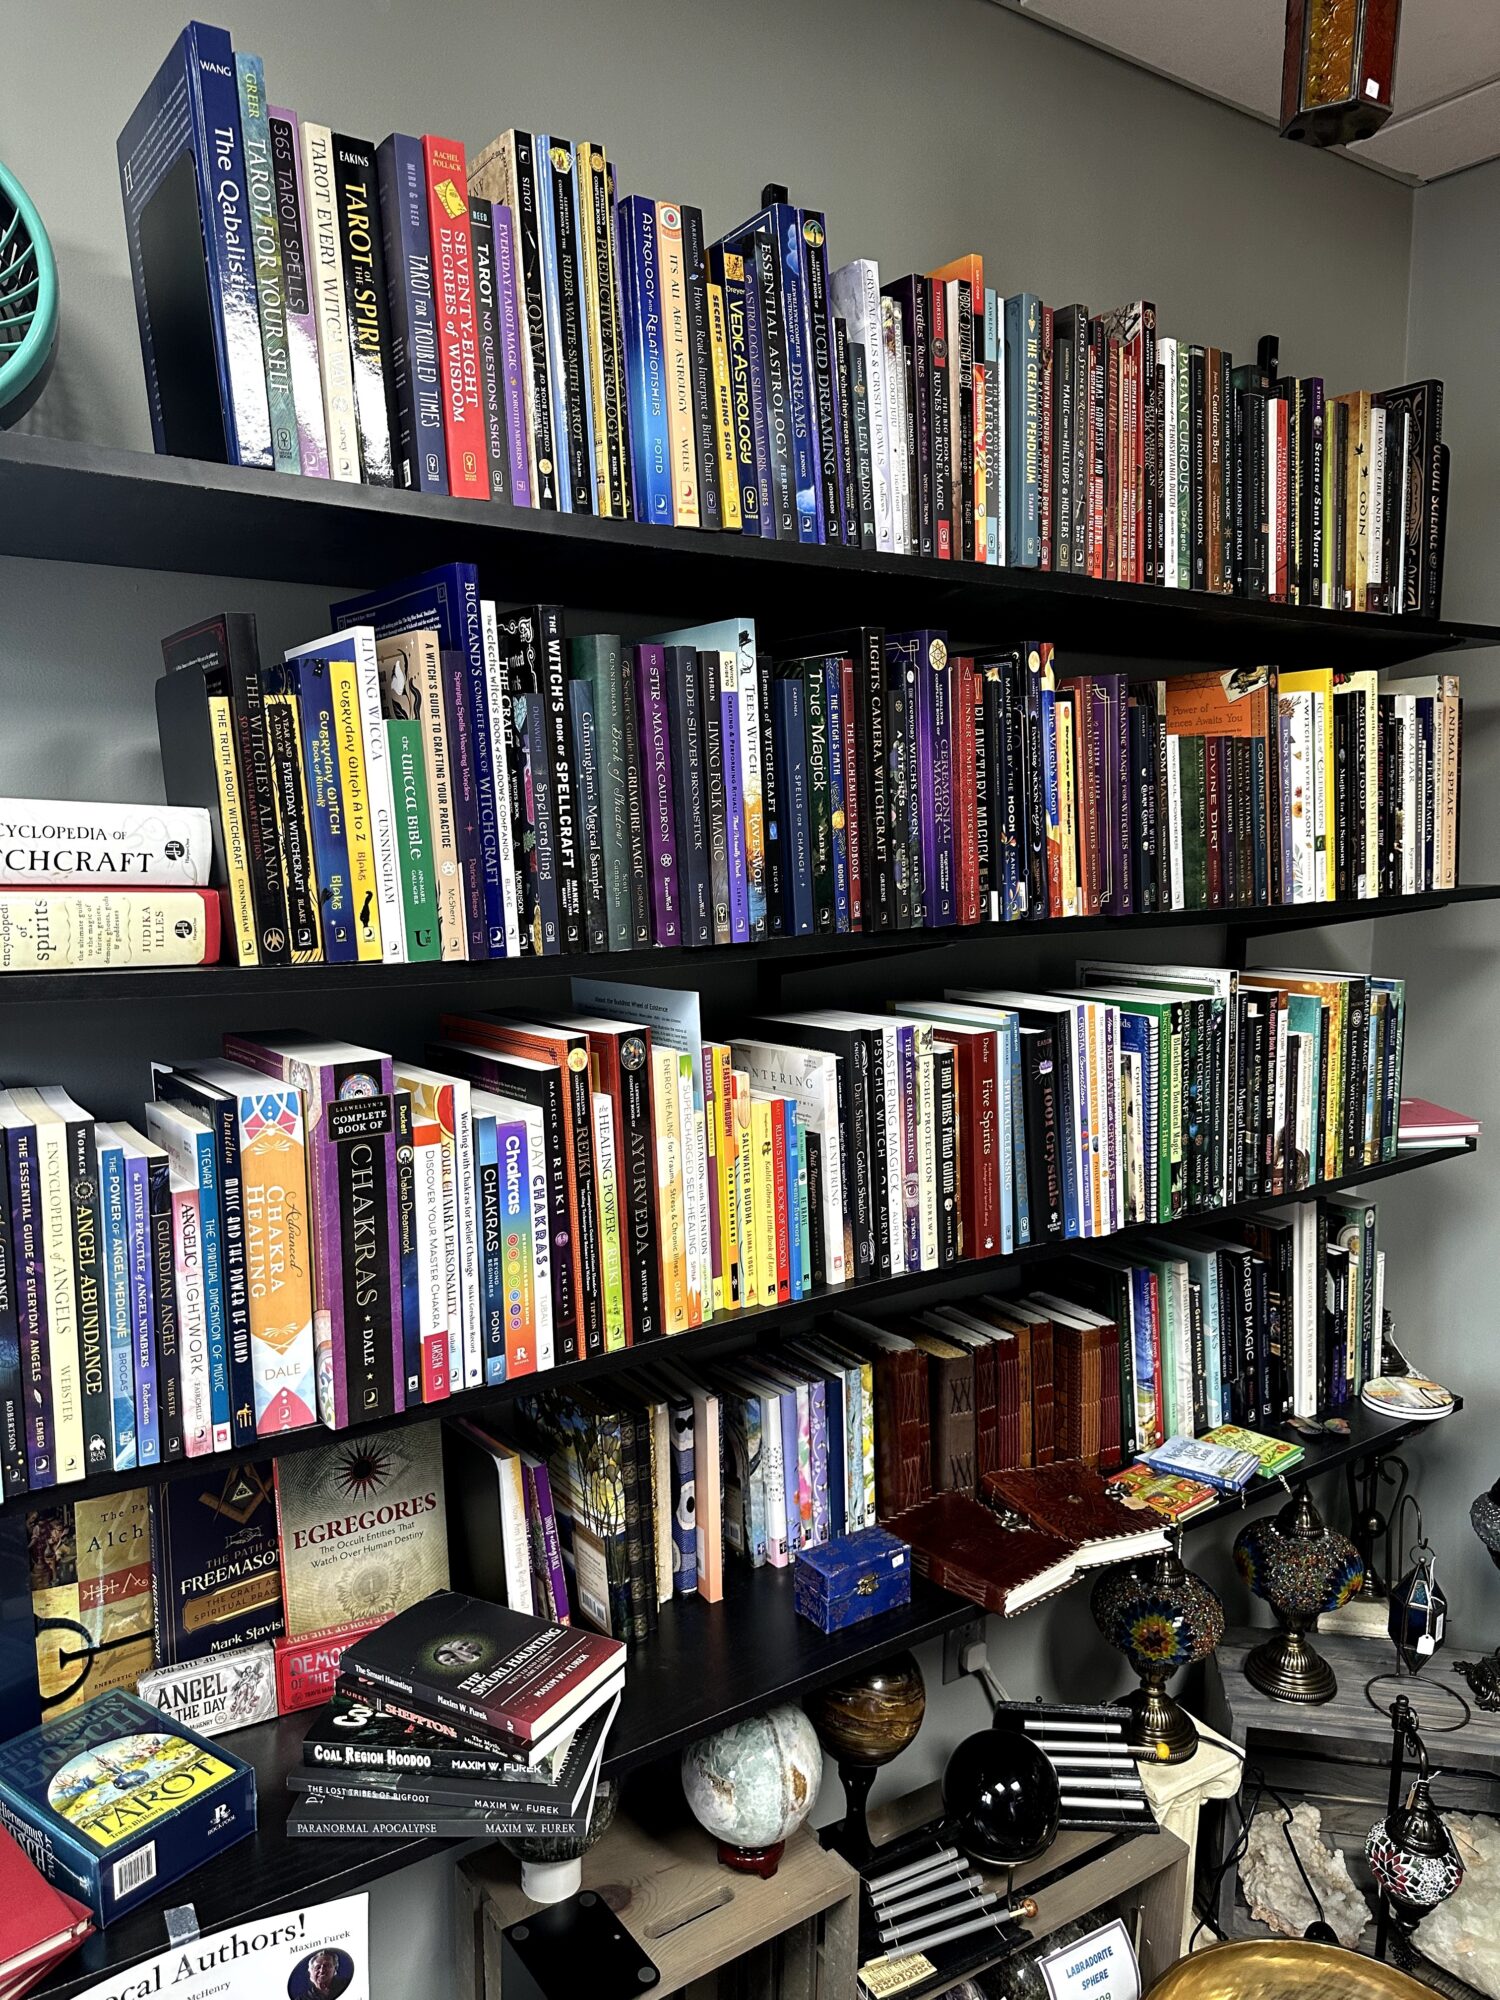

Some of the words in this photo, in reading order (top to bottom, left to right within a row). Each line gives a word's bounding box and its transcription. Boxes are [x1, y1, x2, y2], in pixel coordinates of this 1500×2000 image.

[200, 59, 232, 77] WANG
[245, 72, 260, 119] GREER
[215, 127, 232, 173] The
[273, 124, 290, 160] 365
[340, 151, 369, 167] EAKINS
[432, 159, 461, 172] POLLACK
[433, 151, 459, 162] RACHEL
[247, 138, 271, 217] TAROT
[277, 166, 297, 234] TAROT
[216, 177, 245, 305] Qabalistic
[345, 183, 371, 260] TAROT
[254, 223, 276, 270] FOR
[285, 240, 304, 307] SPELLS
[440, 228, 457, 316] DEGREES
[477, 244, 493, 307] TAROT
[761, 243, 778, 340] ESSENTIAL
[260, 274, 281, 337] YOUR
[446, 319, 455, 337] of
[454, 231, 478, 407] SEVENTY-EIGHT
[483, 312, 492, 330] NO
[729, 301, 744, 353] VEDIC
[814, 313, 827, 370] LUCID
[1026, 338, 1036, 360] THE
[267, 341, 288, 394] SELF
[445, 342, 465, 422] WISDOM
[482, 335, 497, 404] QUESTIONS
[1179, 352, 1188, 396] PAGAN
[734, 356, 752, 464] ASTROLOGY
[768, 348, 788, 459] ASTROLOGY
[1027, 363, 1036, 422] CREATIVE
[490, 407, 500, 460] ASKED
[817, 376, 834, 476] DREAMING
[1179, 402, 1190, 494] CURIOUS
[1026, 426, 1036, 484] PENDULUM
[1314, 442, 1322, 481] Secrets
[1314, 498, 1322, 526] Santa
[1313, 530, 1321, 568] Muerte
[361, 637, 377, 698] LIVING
[548, 639, 565, 713] WITCH'S
[869, 635, 880, 695] LIGHTS,
[809, 669, 823, 716] True
[216, 708, 225, 727] THE
[367, 703, 381, 762] WICCA
[555, 717, 563, 741] BOOK
[871, 698, 883, 760] CAMERA,
[220, 731, 230, 765] TRUTH
[558, 745, 565, 757] OF
[708, 720, 720, 764] LIVING
[811, 724, 826, 792] Magick
[224, 768, 235, 802] ABOUT
[710, 769, 722, 810] FOLK
[113, 831, 128, 840] OF
[556, 760, 575, 869] SPELLCRAFT
[875, 765, 886, 863] WITCHCRAFT
[0, 849, 153, 872] CHCRAFT
[228, 808, 244, 872] WITCHCRAFT
[377, 809, 395, 904] CUNNINGHAM
[712, 815, 724, 862] MAGIC
[36, 900, 56, 961] spirits
[142, 906, 150, 952] JUDIKA
[156, 910, 164, 948] ILLES
[874, 1039, 884, 1104] PSYCHIC
[1172, 1037, 1182, 1089] Blackthorn's
[982, 1078, 994, 1107] Five
[1172, 1090, 1182, 1132] Botanical
[332, 1110, 387, 1125] COMPLETE
[337, 1121, 366, 1134] BOOK
[368, 1120, 383, 1131] OF
[875, 1109, 885, 1158] WITCH
[983, 1111, 994, 1155] Spirits
[76, 1128, 86, 1175] WOMACK
[742, 1132, 750, 1186] SALTWATER
[1171, 1134, 1181, 1155] Magic
[425, 1150, 435, 1199] DISCOVER
[504, 1135, 520, 1216] Chakras
[630, 1131, 649, 1256] AYURVEDA
[76, 1204, 93, 1274] ANGEL
[181, 1203, 199, 1268] ANGELIC
[266, 1185, 286, 1293] CHAKRA
[285, 1190, 303, 1278] Advanced
[350, 1144, 379, 1307] CHAKRAS
[427, 1202, 436, 1230] YOUR
[246, 1184, 266, 1299] HEALING
[428, 1234, 438, 1279] MASTER
[431, 1283, 440, 1329] CHAKRA
[1241, 1256, 1253, 1314] MORBID
[80, 1277, 102, 1396] ABUNDANCE
[185, 1272, 205, 1376] LIGHTWORK
[363, 1328, 374, 1366] DALE
[1244, 1318, 1255, 1361] MAGIC
[263, 1362, 301, 1381] DALE
[432, 1339, 442, 1370] LARSEN
[35, 1416, 45, 1448] LEMBO
[293, 1492, 437, 1549] EGREGORES
[320, 1546, 334, 1554] The
[337, 1536, 364, 1549] Occult
[367, 1528, 395, 1540] Entities
[398, 1522, 415, 1531] That
[311, 1556, 337, 1569] Watch
[340, 1550, 361, 1560] Over
[364, 1540, 392, 1553] Human
[395, 1531, 424, 1544] Destiny
[355, 1665, 367, 1675] The
[367, 1670, 384, 1682] Smurl
[385, 1676, 412, 1693] Haunting
[457, 1672, 486, 1691] THE
[470, 1663, 512, 1695] SMURL
[509, 1628, 561, 1667] HAUNTING
[157, 1673, 227, 1709] ANGEL
[175, 1707, 200, 1722] THE
[203, 1696, 227, 1714] DAY
[438, 1695, 458, 1709] Maxim
[458, 1703, 468, 1713] W.
[469, 1706, 487, 1720] Furek
[315, 1745, 342, 1761] COAL
[346, 1747, 384, 1764] REGION
[387, 1751, 431, 1767] HOODOO
[452, 1759, 486, 1771] MAXIM
[488, 1762, 501, 1771] W.
[504, 1763, 541, 1773] FUREK
[82, 1758, 216, 1835] TAROT
[308, 1785, 323, 1794] THE
[326, 1787, 347, 1795] LOST
[349, 1789, 377, 1798] TRIBES
[393, 1793, 429, 1803] BIGFOOT
[475, 1800, 507, 1810] MAXIM
[511, 1803, 523, 1811] W.
[527, 1805, 559, 1814] FUREK
[208, 1815, 235, 1836] ROCKPOOL
[297, 1824, 368, 1833] PARANORMAL
[373, 1824, 437, 1833] APOCALYPSE
[485, 1824, 522, 1833] MAXIM
[526, 1824, 537, 1833] W.
[541, 1824, 575, 1833] FUREK
[171, 1913, 306, 1984] Authors!
[290, 1940, 321, 1954] Maxim
[324, 1930, 350, 1946] Furek
[1066, 1946, 1114, 1979] LABRADORITE
[187, 1980, 231, 2000] McHenry
[1082, 1971, 1109, 1990] SPHERE
